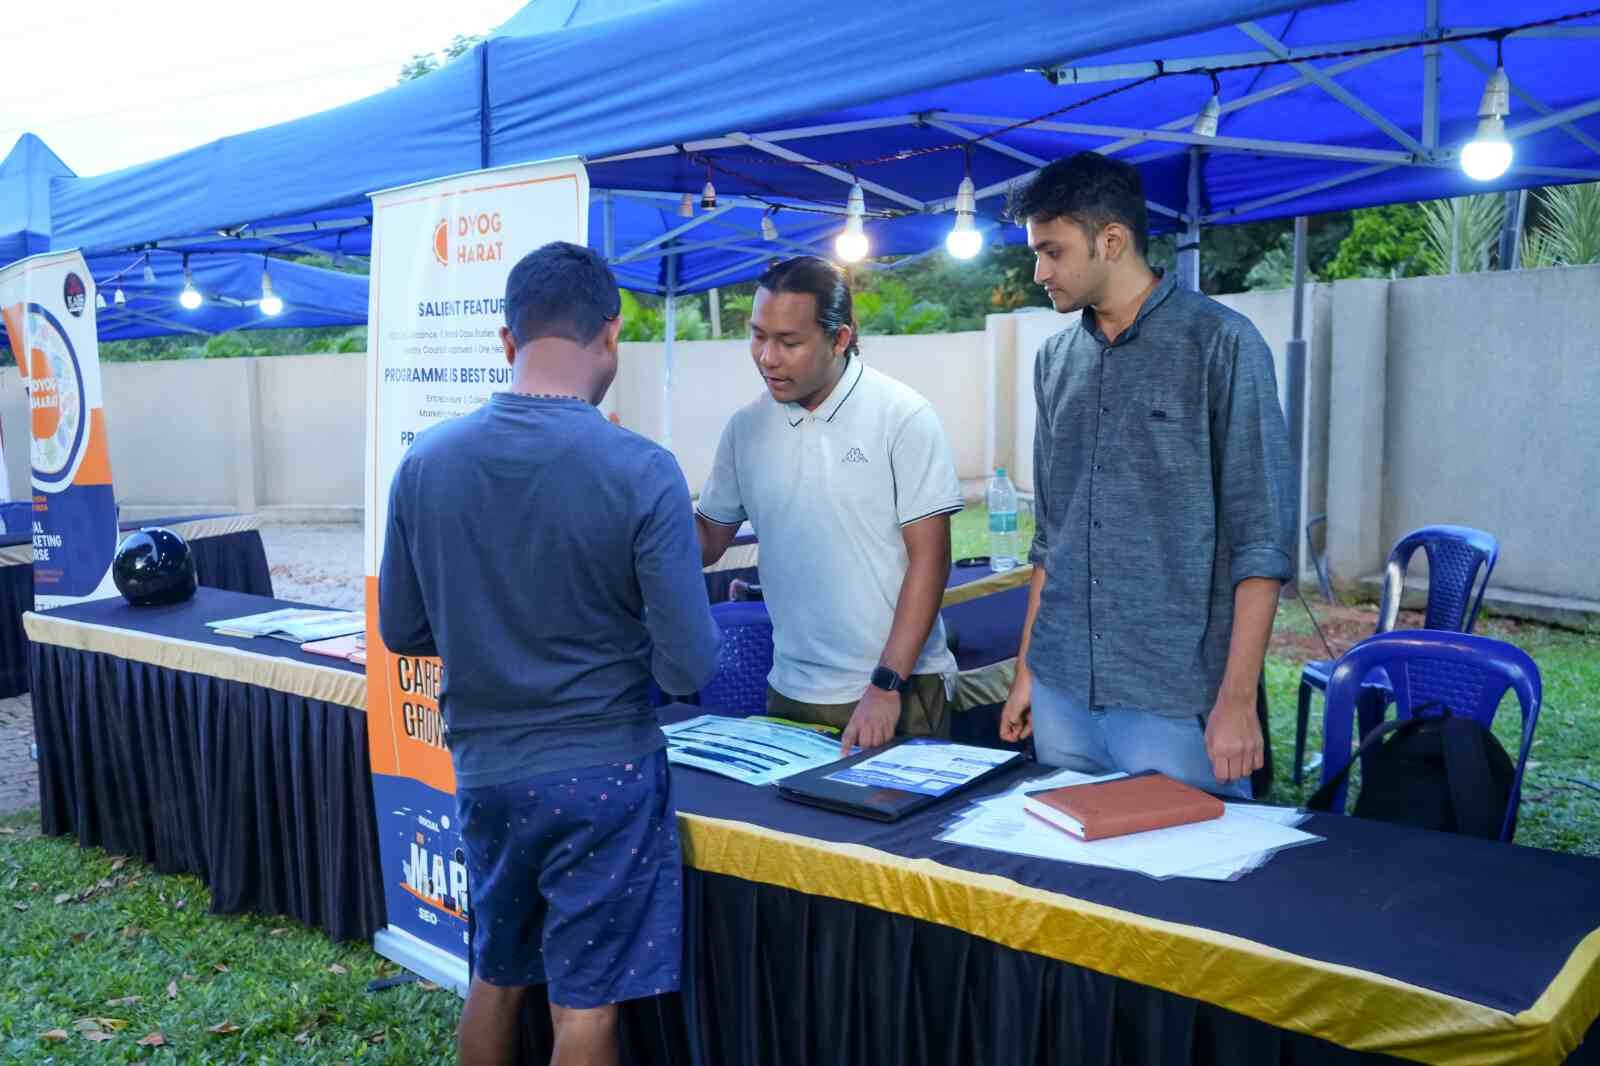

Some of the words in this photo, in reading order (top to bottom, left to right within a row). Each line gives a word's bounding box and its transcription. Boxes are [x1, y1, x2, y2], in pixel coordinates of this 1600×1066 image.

[457, 240, 503, 263] HARAT
[384, 367, 448, 383] PROGRAMME
[460, 367, 486, 383] BEST
